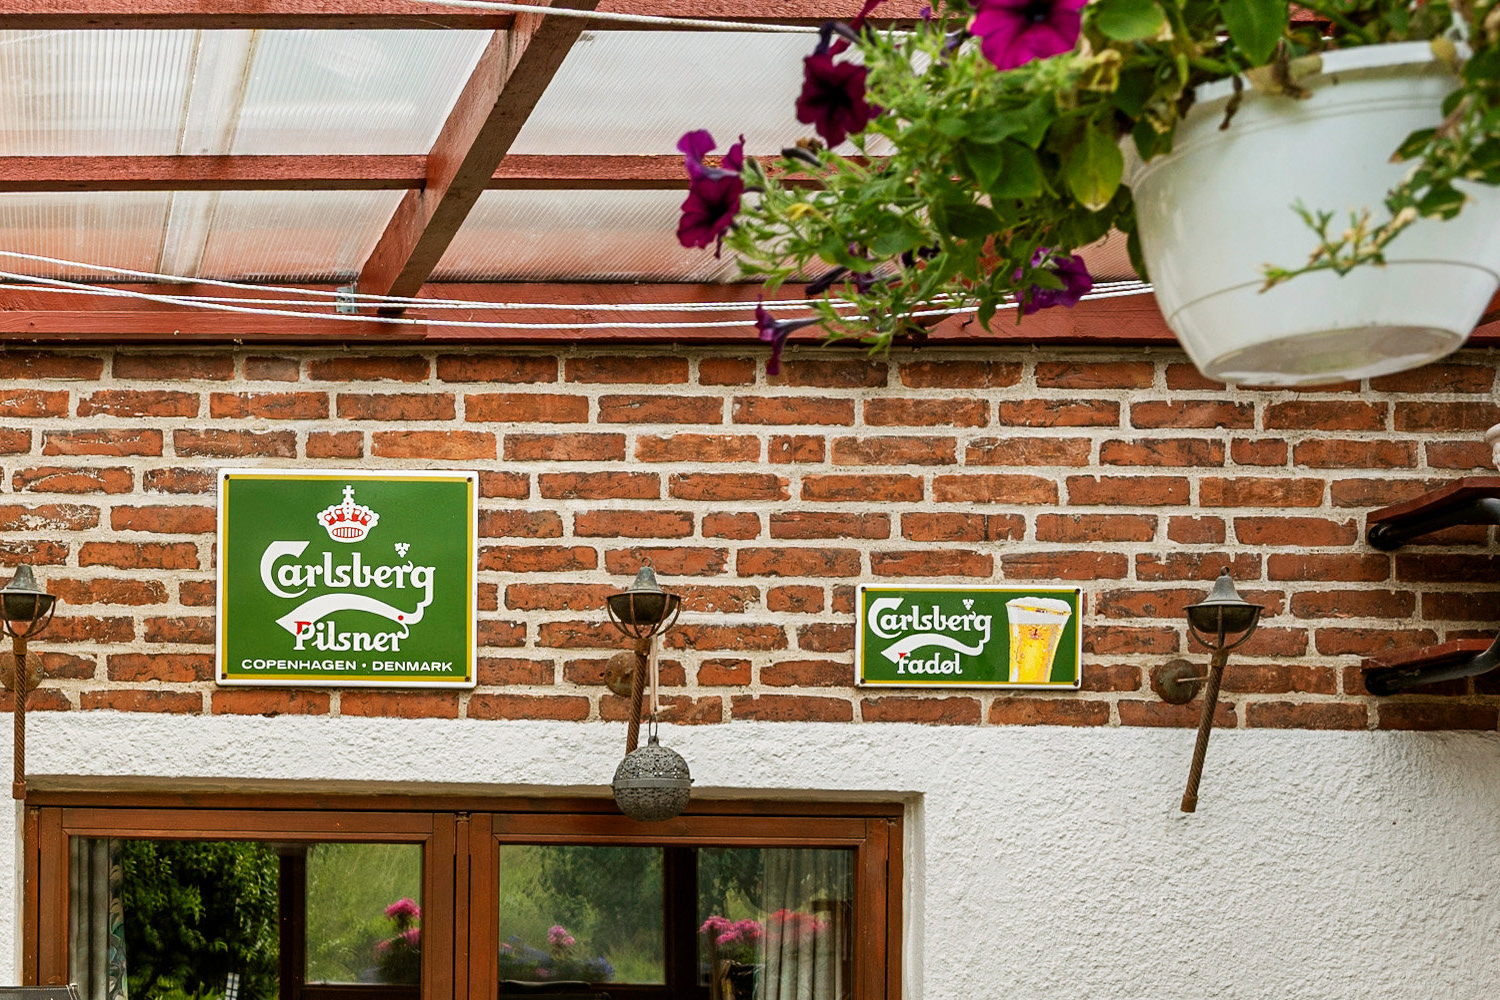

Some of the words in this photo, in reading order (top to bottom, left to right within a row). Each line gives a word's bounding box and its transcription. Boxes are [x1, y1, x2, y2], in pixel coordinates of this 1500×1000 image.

[260, 540, 436, 607] Carlsberg
[293, 620, 410, 652] Pilsner
[867, 597, 993, 642] Carlsberg
[241, 658, 357, 671] COPENHAGEN
[372, 660, 453, 672] DENMARK
